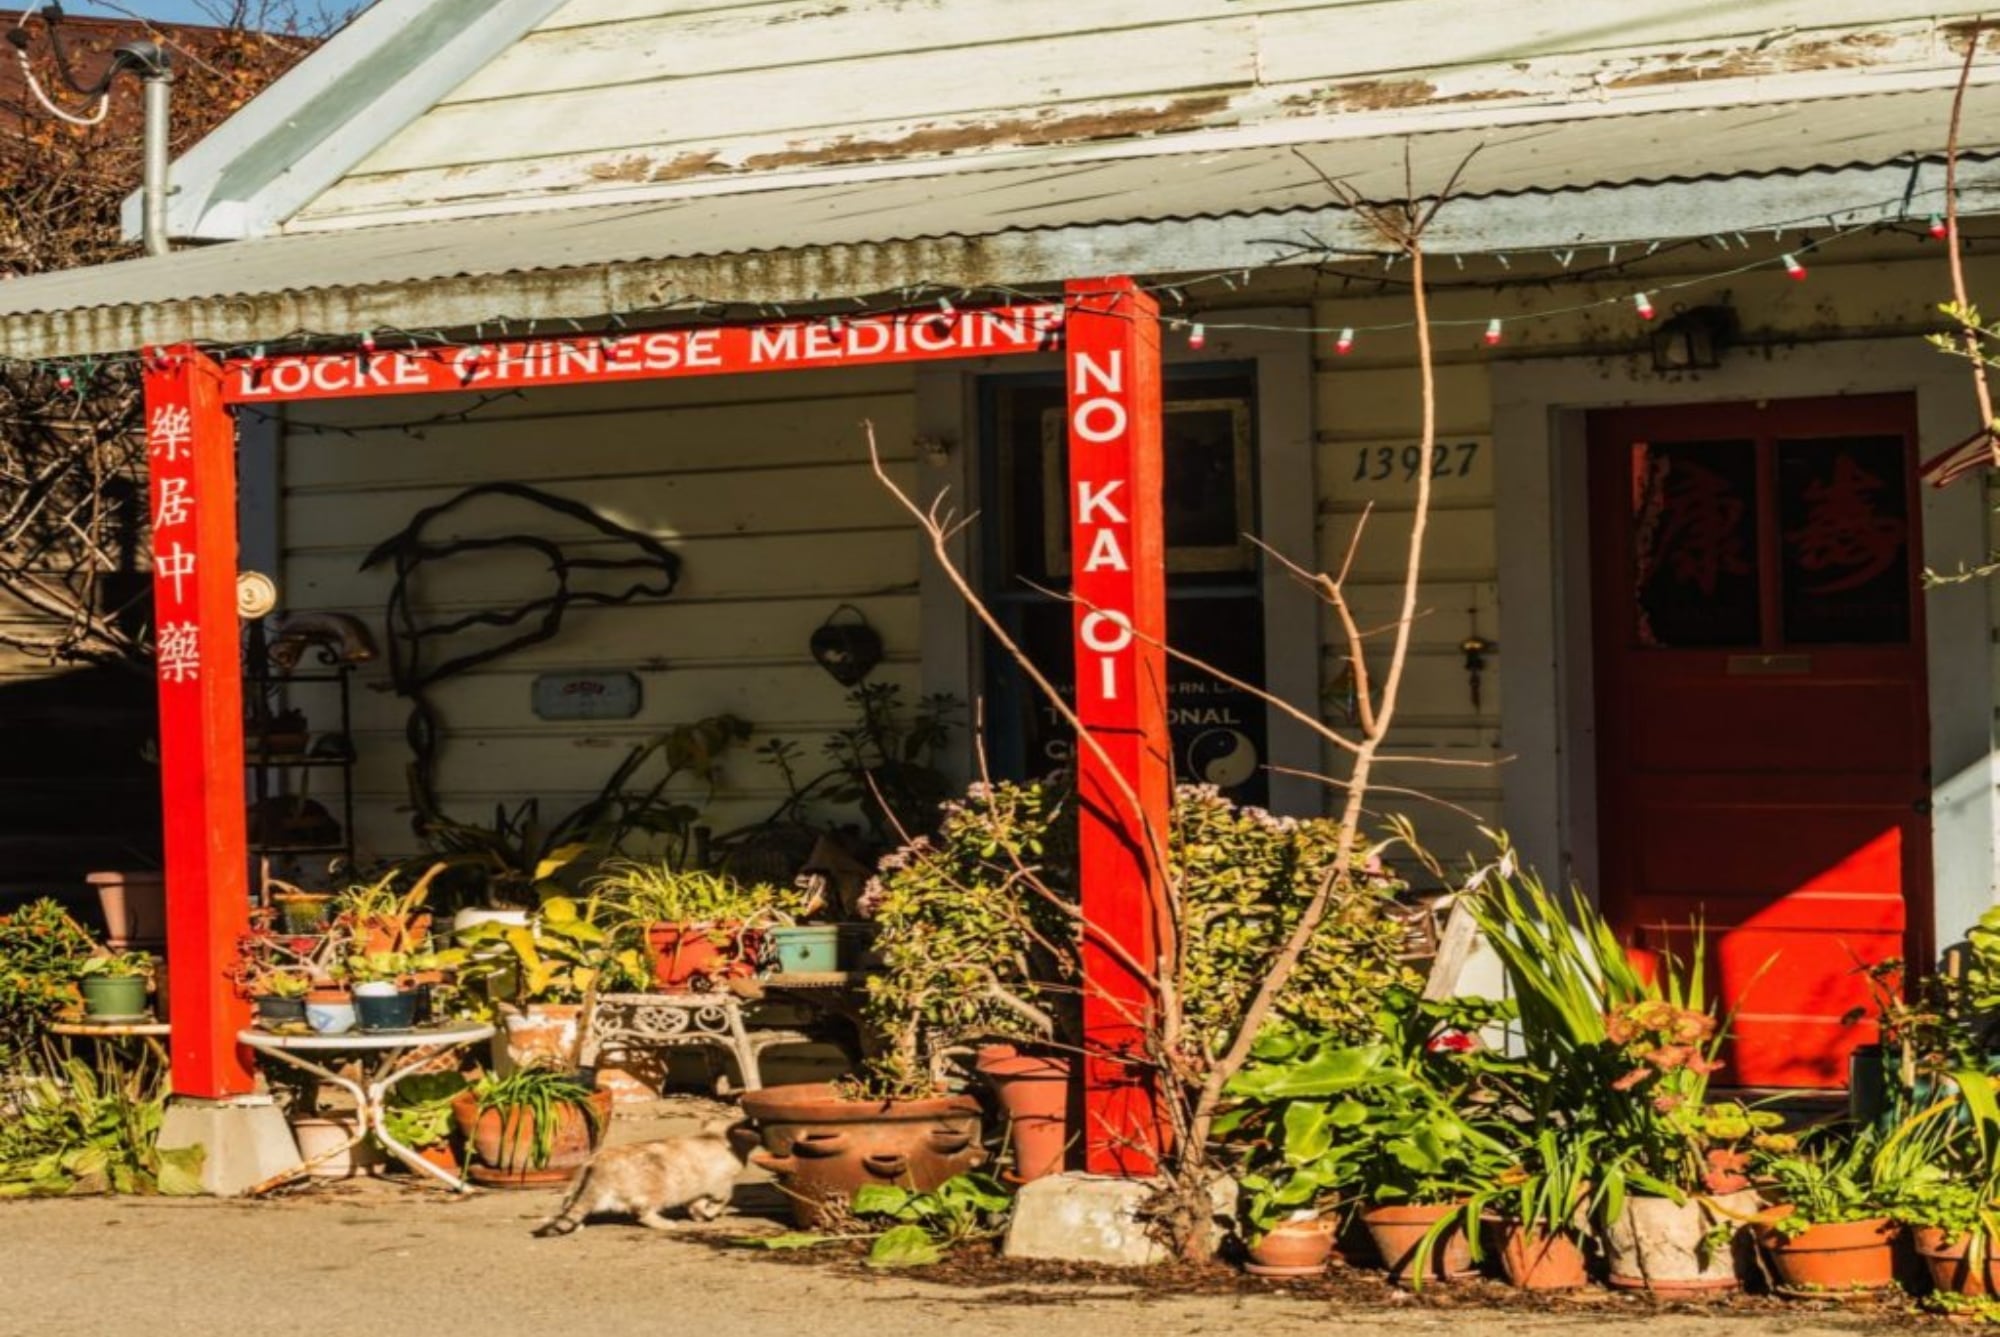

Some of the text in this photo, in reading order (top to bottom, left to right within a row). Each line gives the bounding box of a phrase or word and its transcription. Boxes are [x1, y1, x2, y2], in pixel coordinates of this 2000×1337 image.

[240, 352, 428, 394] LOCKE
[453, 331, 721, 379] CHINESE
[149, 404, 202, 682] 樂居中藥
[1074, 351, 1132, 700] NO KA OI
[1353, 442, 1480, 482] 13927
